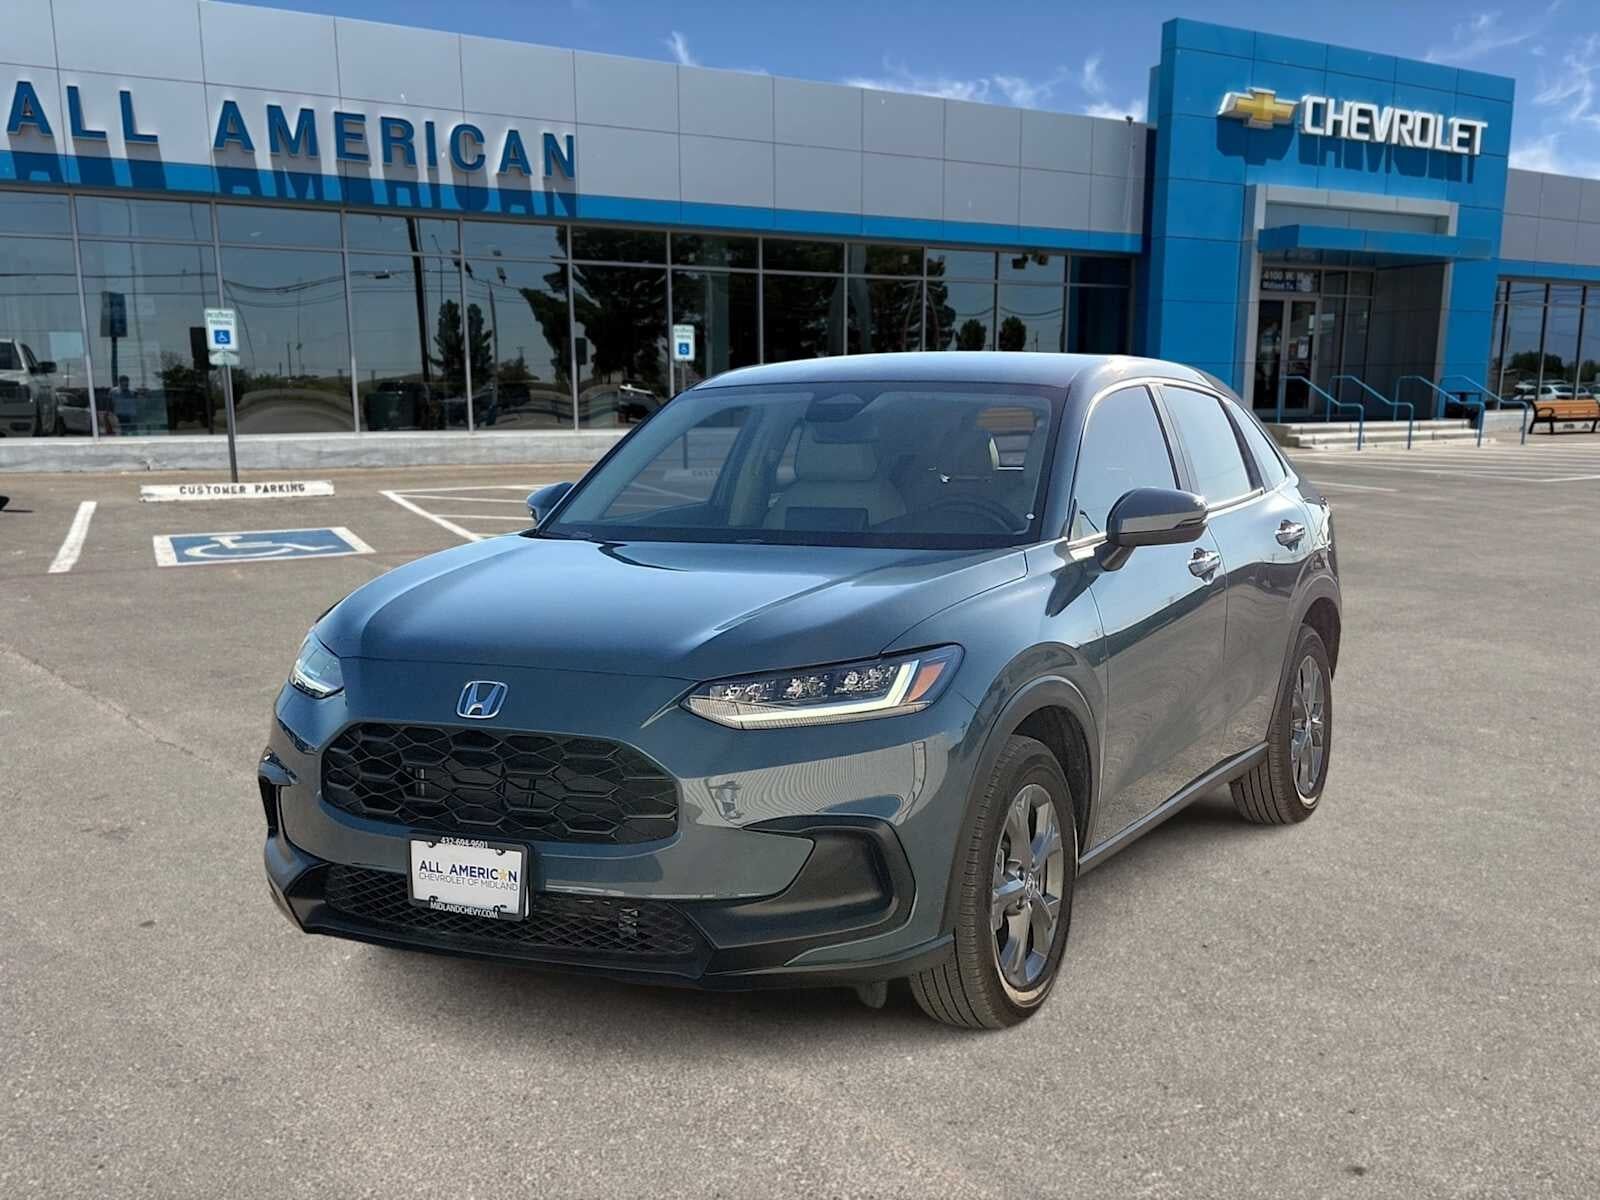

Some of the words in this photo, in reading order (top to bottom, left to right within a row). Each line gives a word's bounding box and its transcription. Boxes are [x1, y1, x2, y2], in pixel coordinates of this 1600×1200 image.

[6, 80, 159, 144] ALL
[213, 100, 576, 179] AMERICAN
[1300, 94, 1488, 156] CHEVROLET
[179, 485, 247, 496] CUSTOMER
[254, 482, 306, 494] PARKING
[419, 860, 443, 873] ALL
[418, 872, 465, 885] CHEVROLET
[467, 876, 479, 885] OF
[480, 879, 518, 892] MIDLAND
[430, 902, 498, 919] MIDLANDCHEVY.COM
